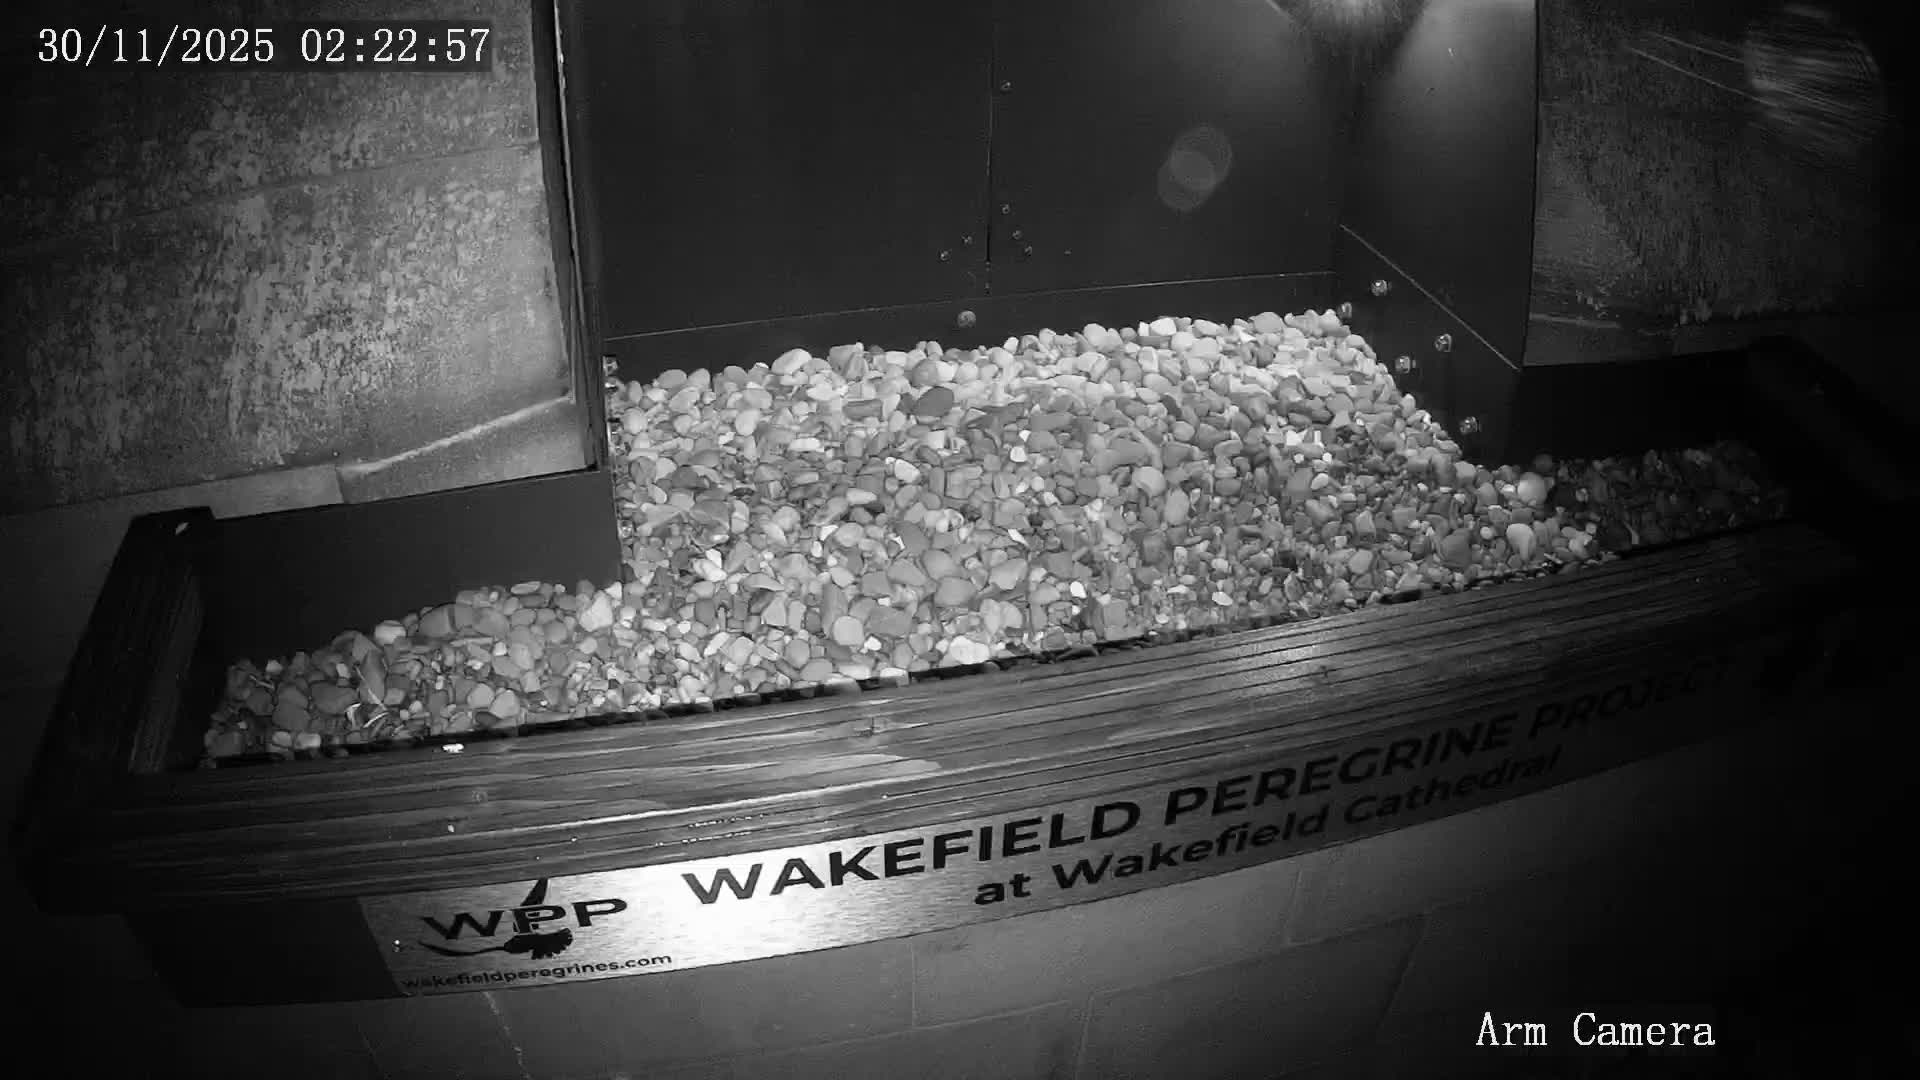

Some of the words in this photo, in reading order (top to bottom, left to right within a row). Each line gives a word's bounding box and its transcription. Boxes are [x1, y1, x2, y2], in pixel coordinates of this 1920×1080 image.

[682, 800, 1141, 904] WAKEFIELD
[1163, 711, 1517, 826] PEREGRINE
[974, 873, 1032, 905] at
[1051, 801, 1328, 889] Wakefield
[1343, 743, 1563, 826] Cathedral
[402, 953, 673, 988] wakefieldperegrines.com
[418, 897, 628, 941] WPP
